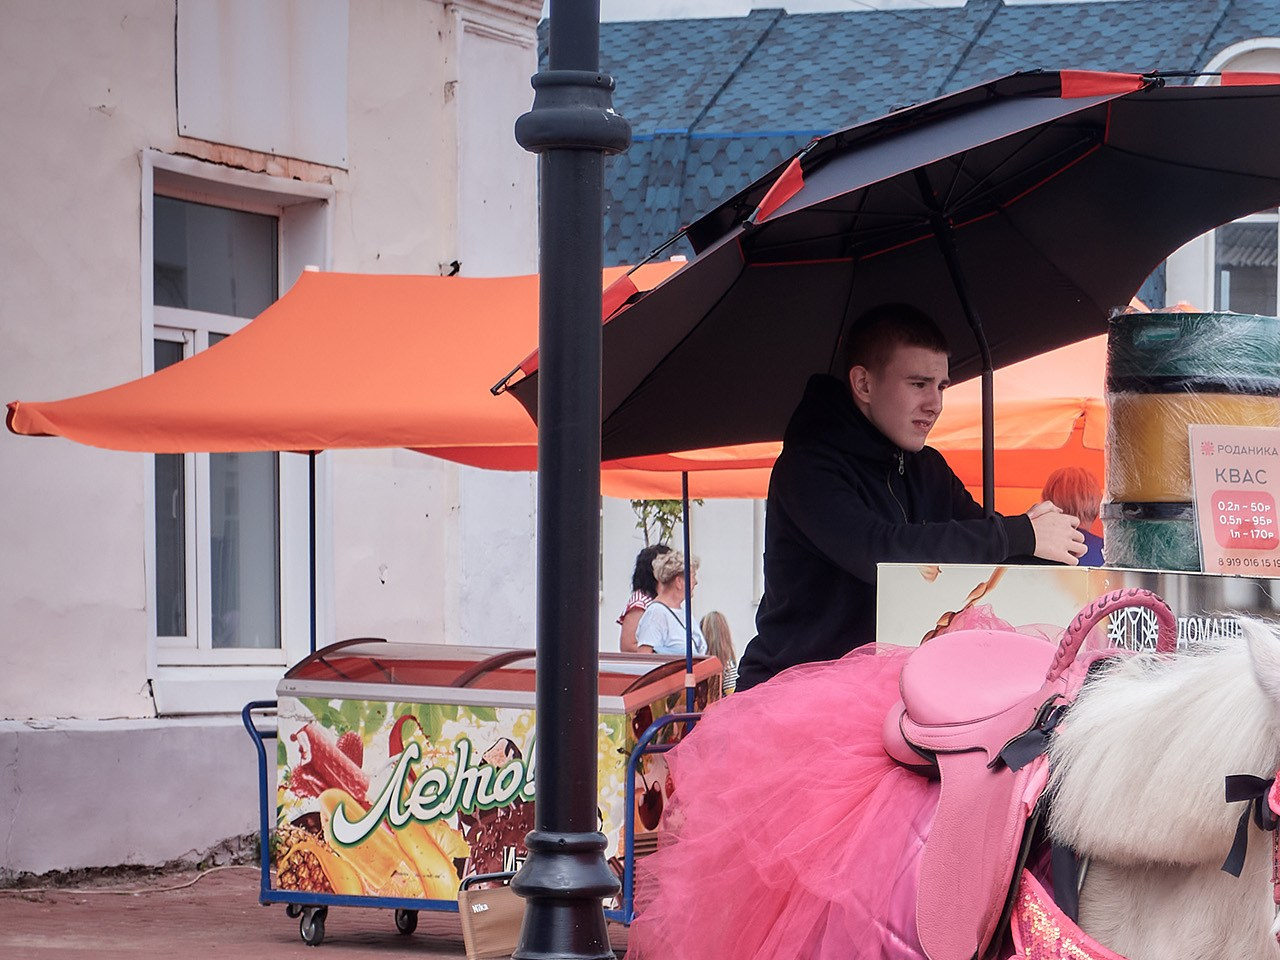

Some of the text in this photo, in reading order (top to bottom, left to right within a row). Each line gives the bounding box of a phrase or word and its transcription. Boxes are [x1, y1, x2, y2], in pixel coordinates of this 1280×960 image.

[1217, 444, 1279, 456] РОДАНИКА
[1215, 468, 1268, 485] КВАС
[1230, 529, 1241, 538] 1л
[1218, 557, 1224, 566] 8
[1226, 557, 1241, 567] 919
[1243, 558, 1260, 567] 016
[1261, 559, 1271, 568] 15
[472, 903, 489, 914] Nika
